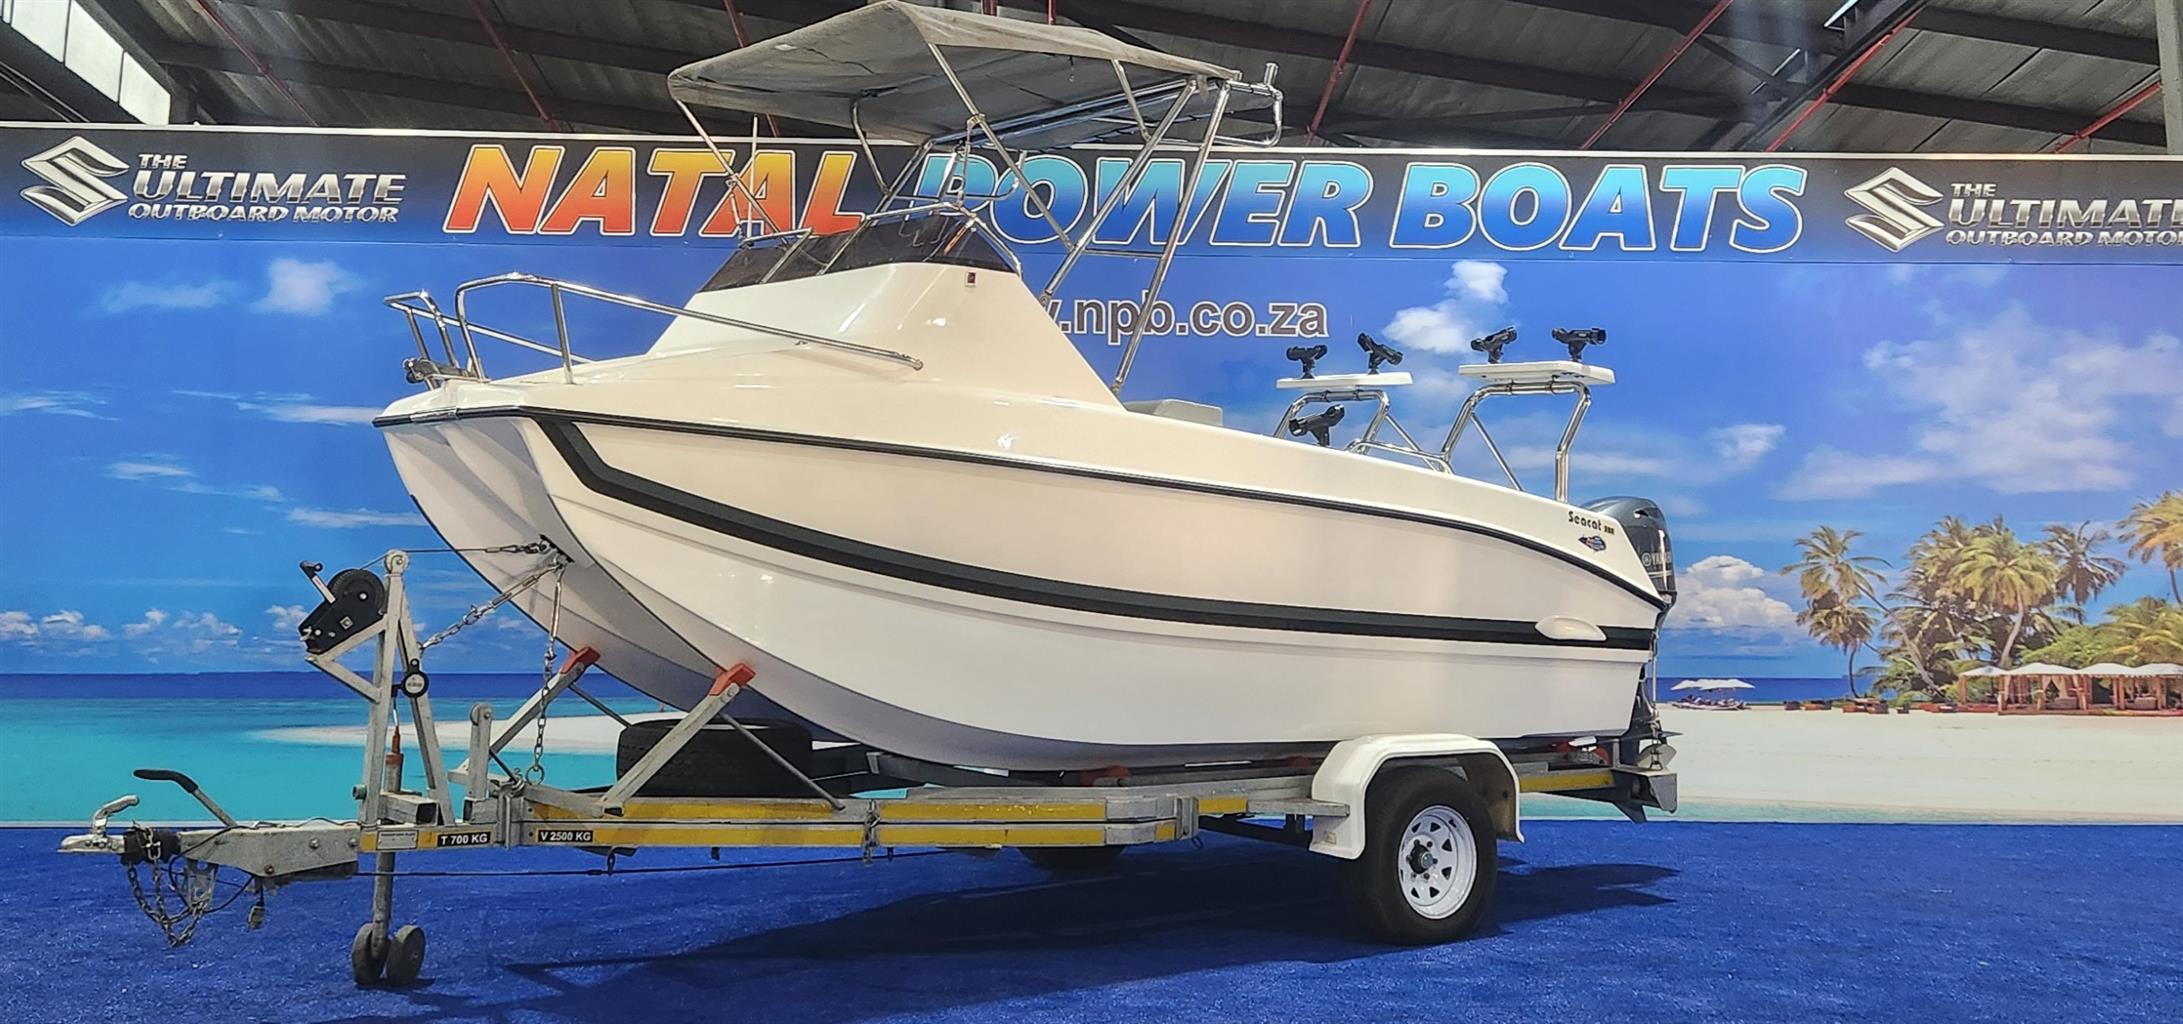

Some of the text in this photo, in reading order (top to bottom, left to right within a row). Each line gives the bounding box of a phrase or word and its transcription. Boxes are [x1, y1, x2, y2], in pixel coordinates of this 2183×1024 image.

[138, 153, 188, 170] THE
[131, 170, 407, 204] ULTIMATE
[1950, 183, 1997, 198] THE
[442, 143, 1808, 253] NATAL POWER BOATS
[128, 203, 400, 223] OUTBOARD MOTOR
[1945, 230, 2095, 246] OUTBOARD
[1568, 511, 1602, 531] Seacat
[440, 832, 488, 846] T 700 KG
[541, 831, 591, 842] V 2500 KG
